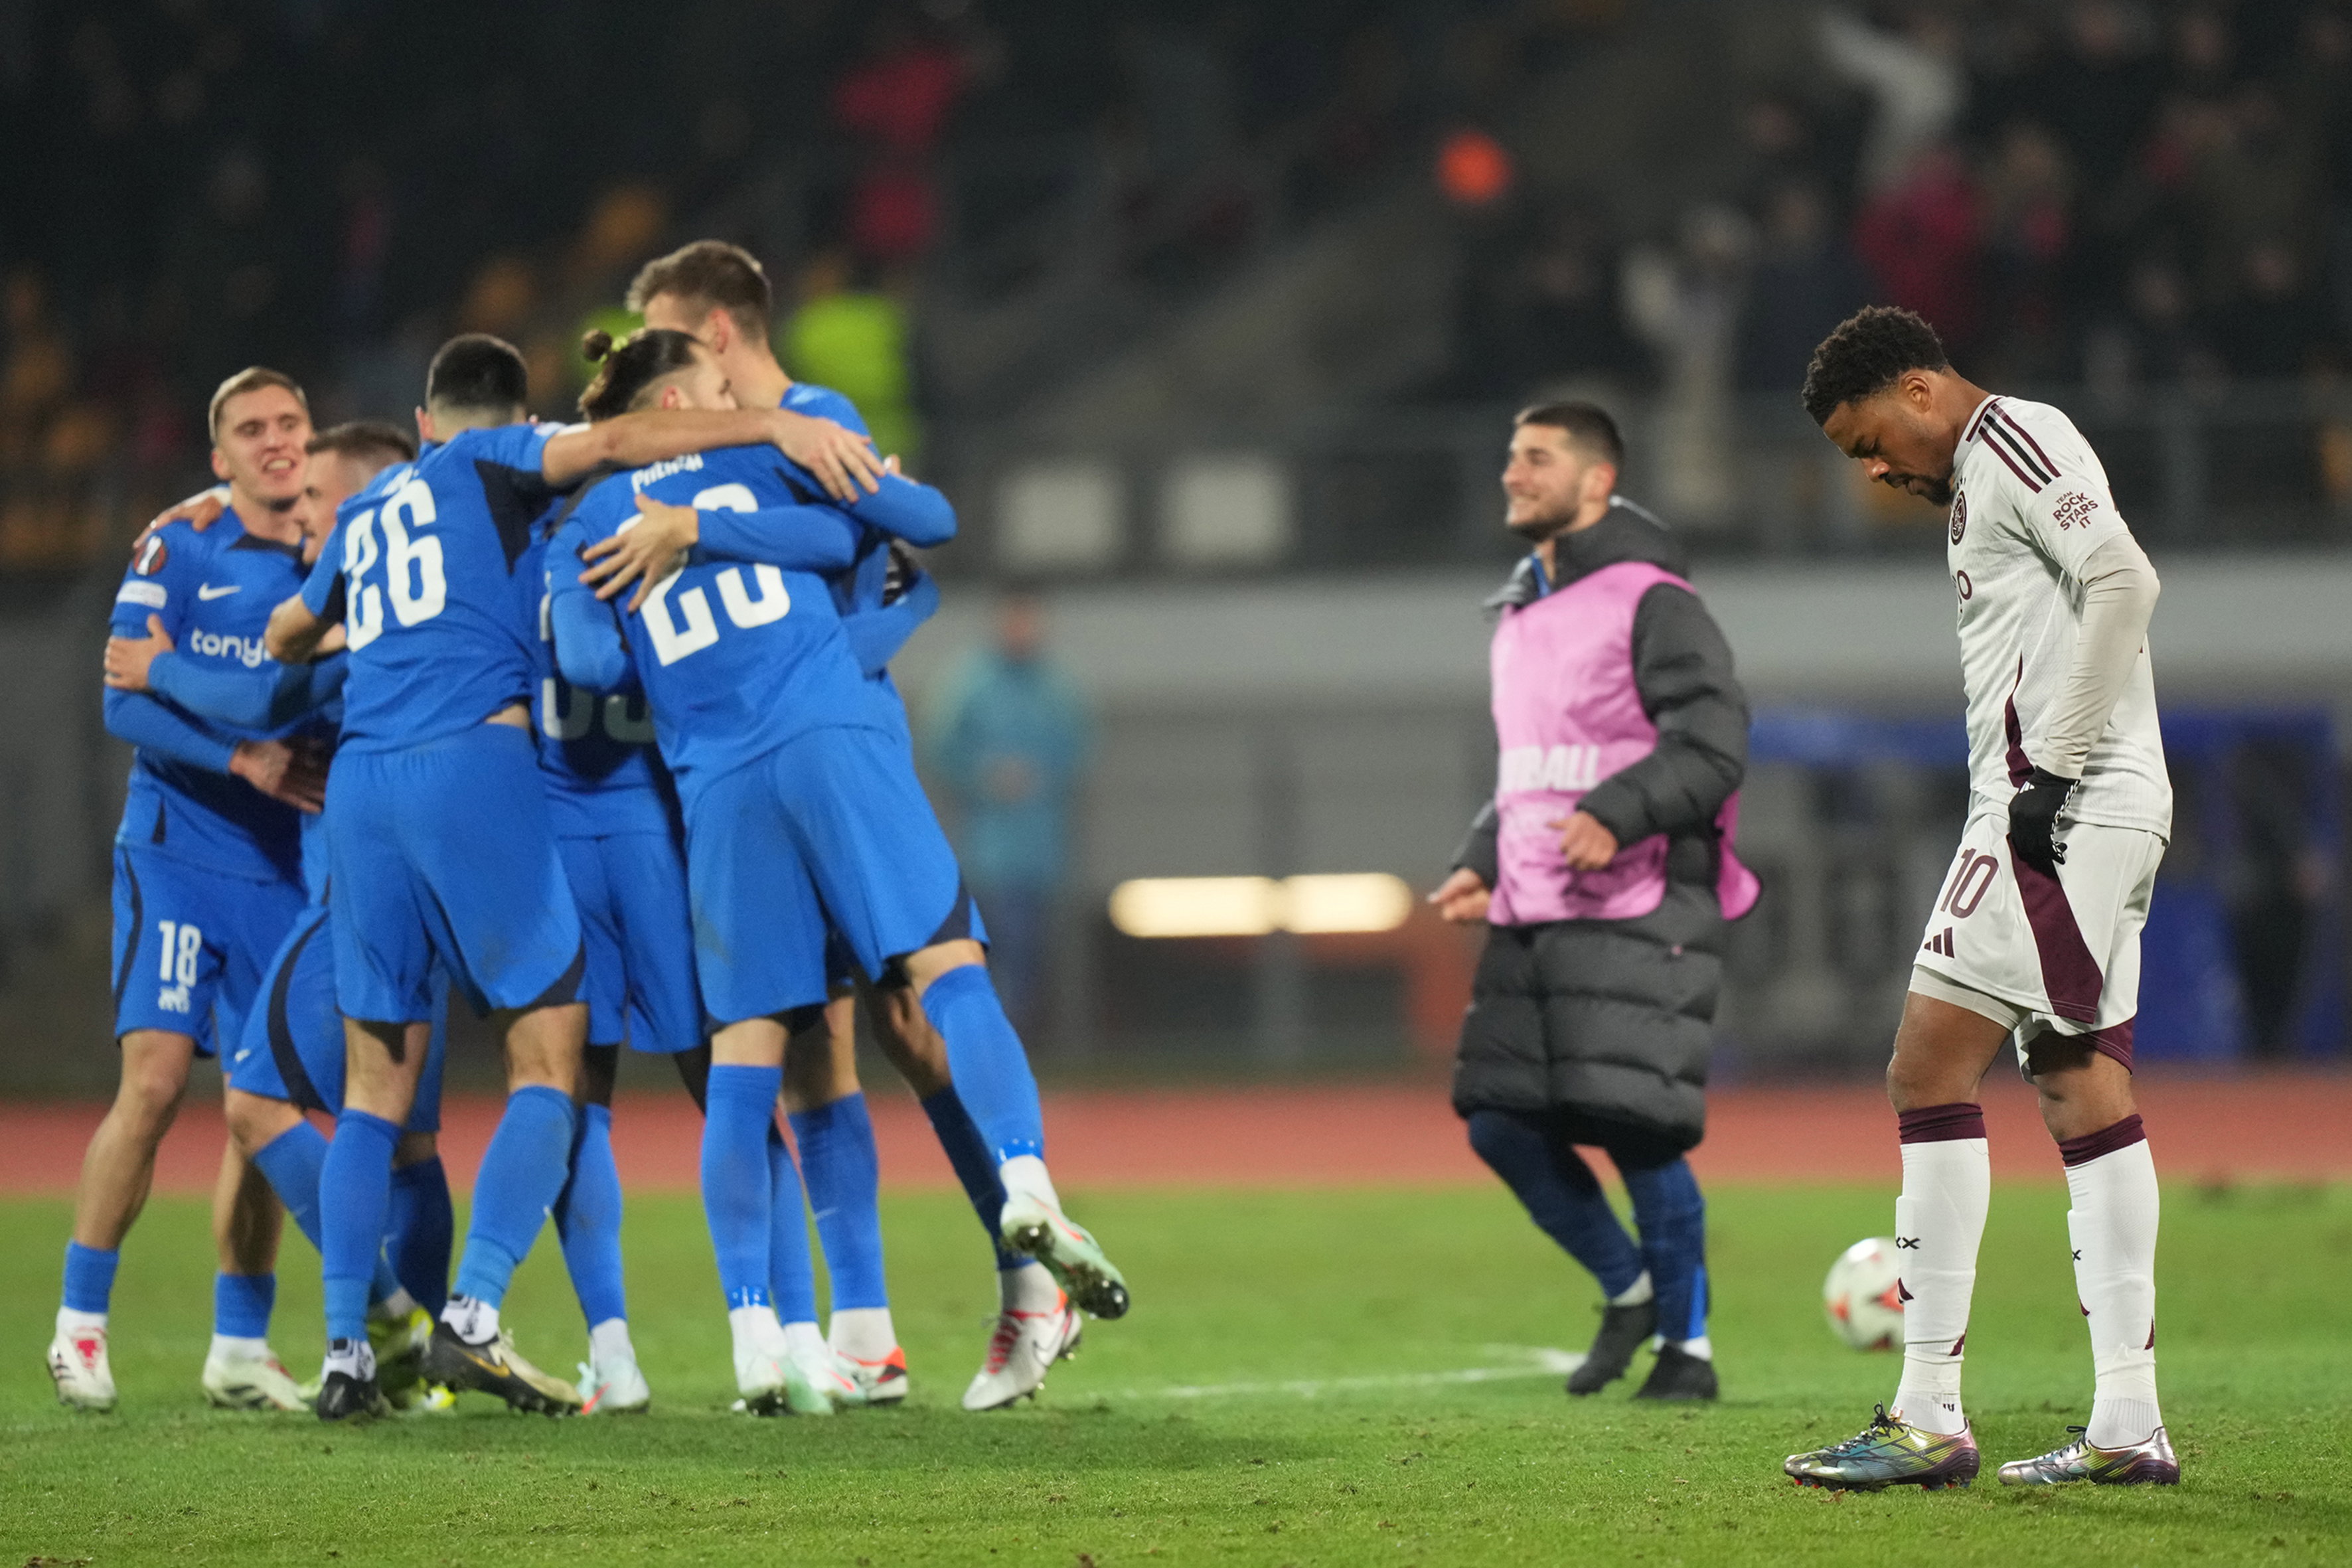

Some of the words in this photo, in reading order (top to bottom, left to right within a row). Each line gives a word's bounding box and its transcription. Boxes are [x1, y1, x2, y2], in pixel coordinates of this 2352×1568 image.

[2053, 493, 2089, 521] ROCK
[2055, 491, 2073, 505] TEAM
[2060, 501, 2098, 531] STARS
[2079, 515, 2091, 529] IT
[343, 478, 447, 653] 26
[191, 626, 273, 668] tony
[1940, 847, 1999, 919] 10
[158, 919, 202, 988] 18
